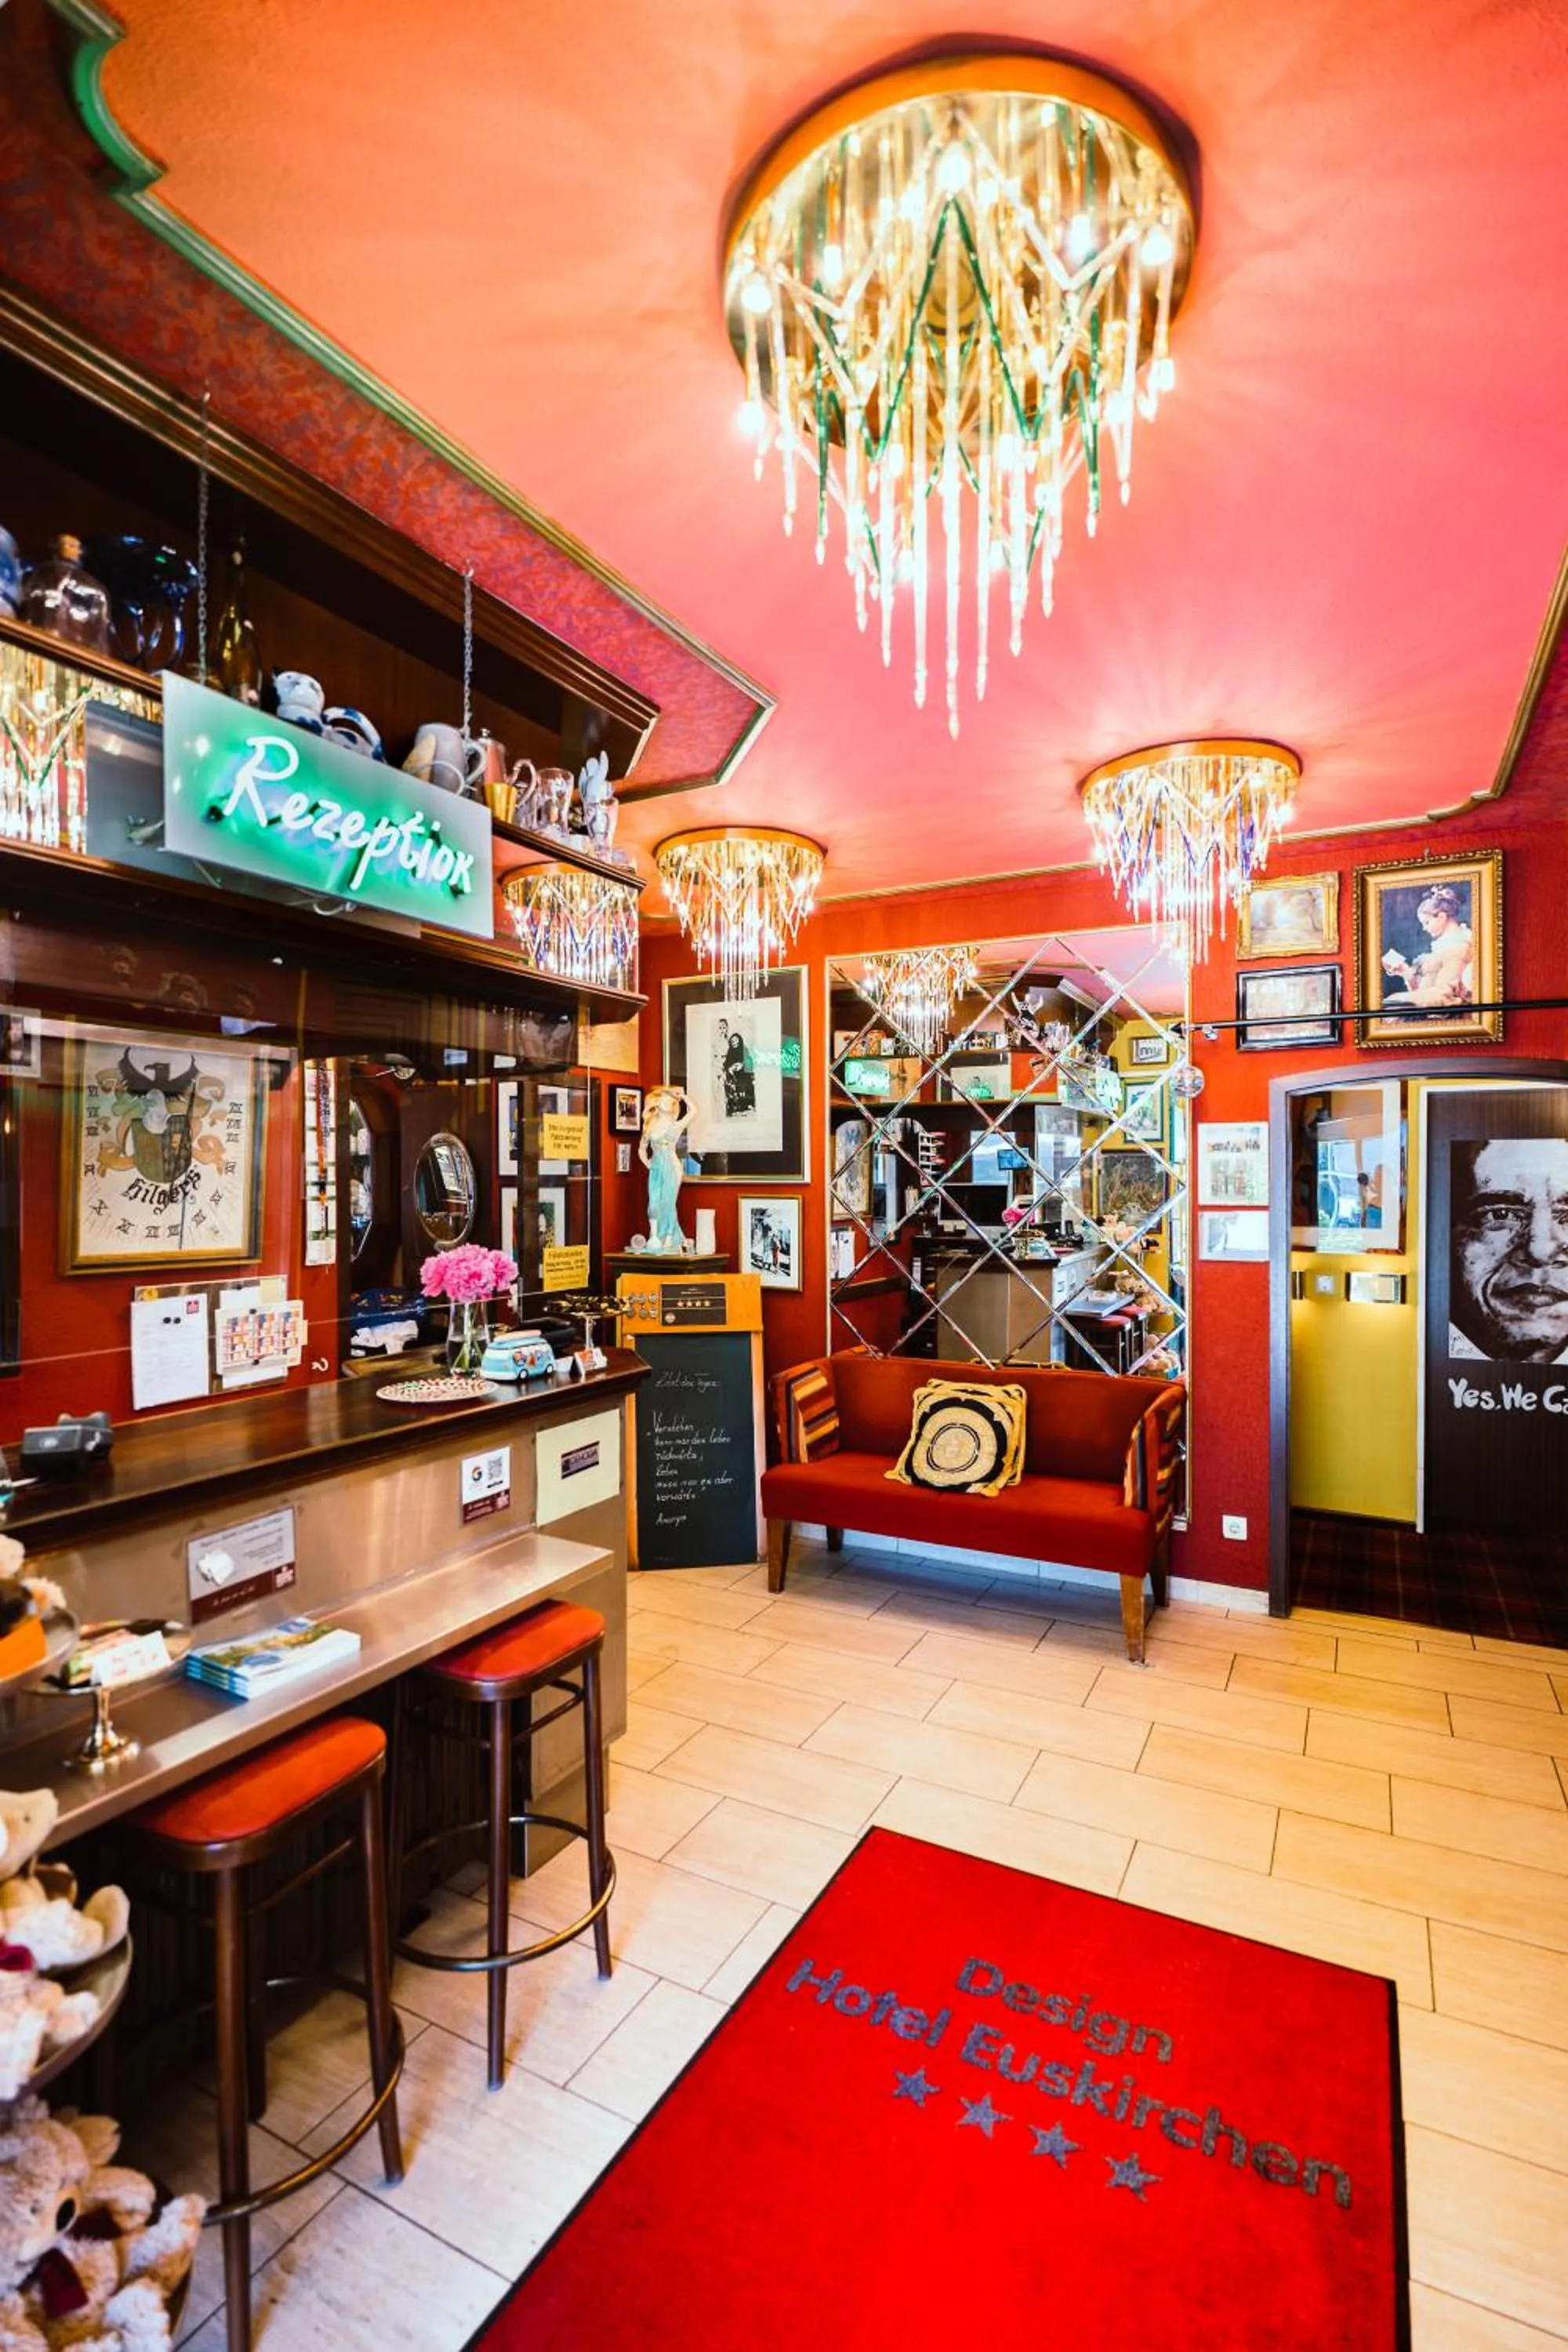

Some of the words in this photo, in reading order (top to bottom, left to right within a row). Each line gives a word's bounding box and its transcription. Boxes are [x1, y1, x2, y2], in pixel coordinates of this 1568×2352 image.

[223, 735, 474, 894] Rezeption
[1501, 1382, 1537, 1410] We
[955, 1956, 1173, 2063] Design
[786, 1958, 952, 2048] Hotel
[960, 2021, 1352, 2209] Euskirchen
